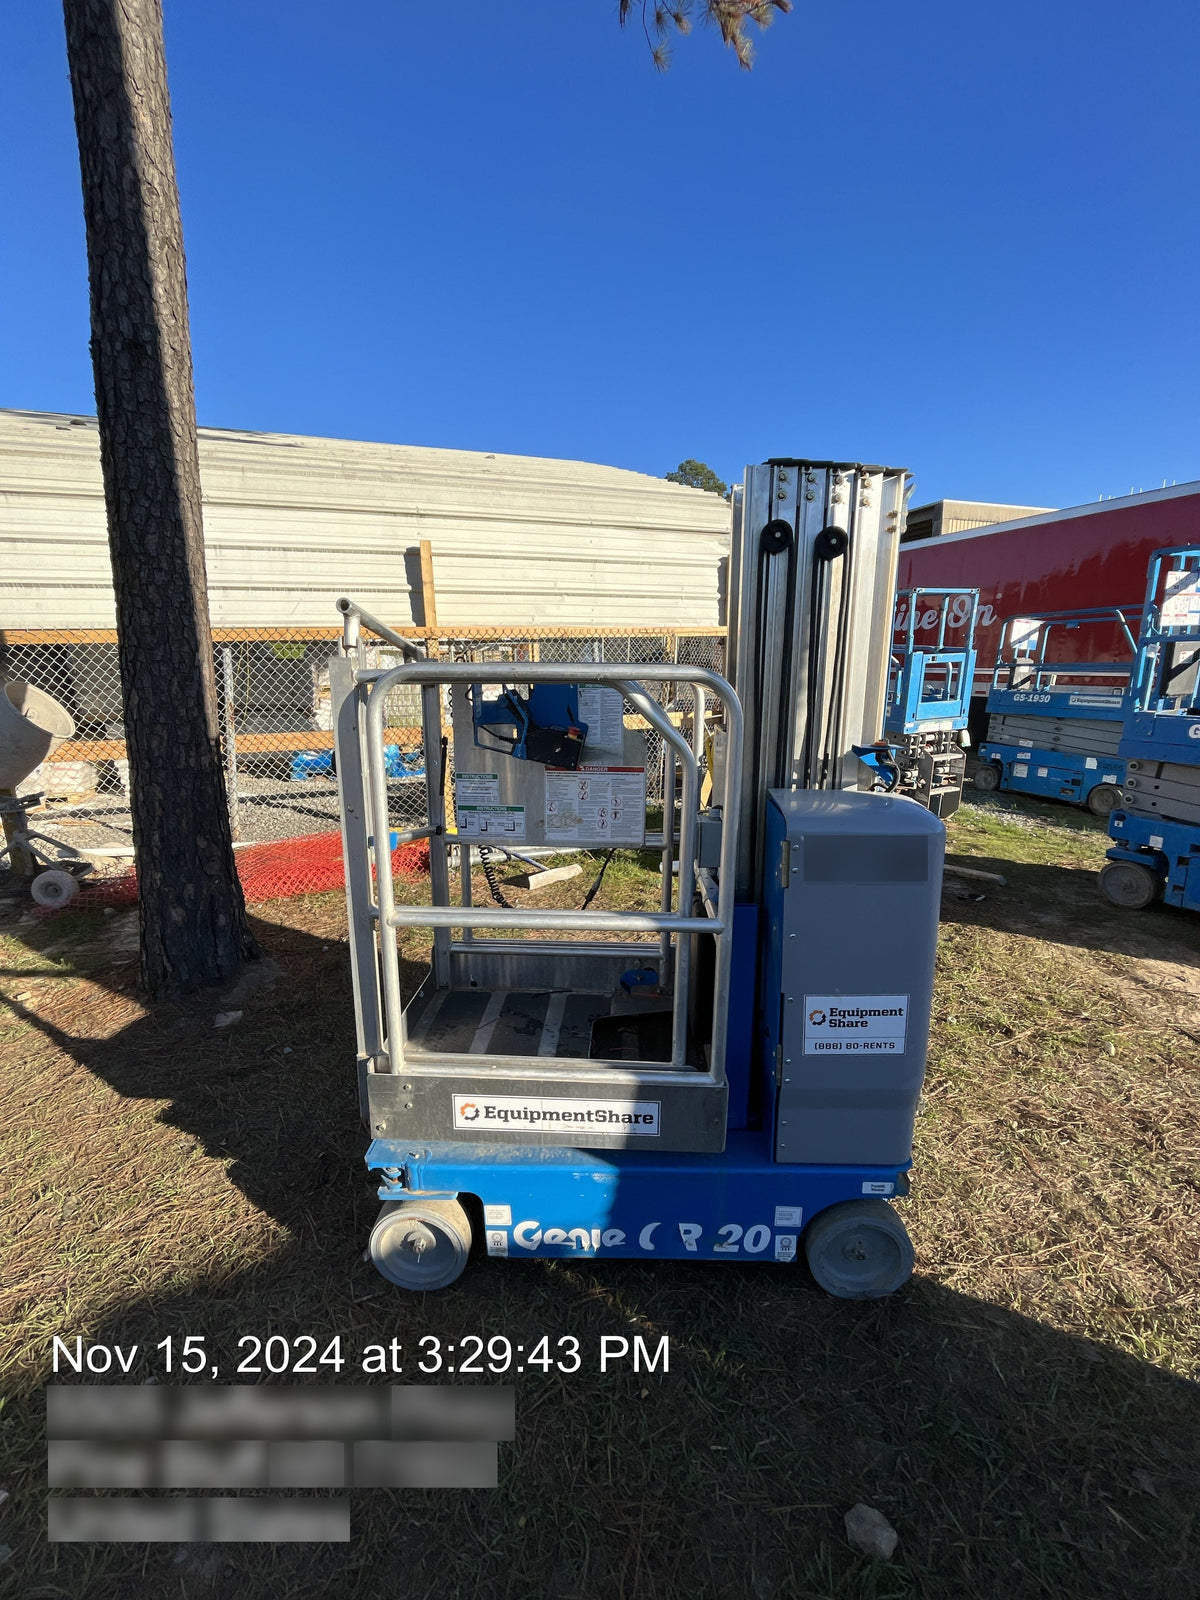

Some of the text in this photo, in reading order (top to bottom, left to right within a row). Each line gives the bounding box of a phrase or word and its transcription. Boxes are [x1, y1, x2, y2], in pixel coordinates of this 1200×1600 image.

[947, 595, 998, 628] On
[1013, 693, 1051, 703] GS-1930
[829, 1007, 904, 1019] Equipment
[828, 1019, 869, 1028] Share
[814, 1042, 896, 1050] (888) 80-RENTS
[483, 1105, 654, 1125] EquipmentShare
[513, 1220, 626, 1252] Genie
[713, 1223, 772, 1254] 20
